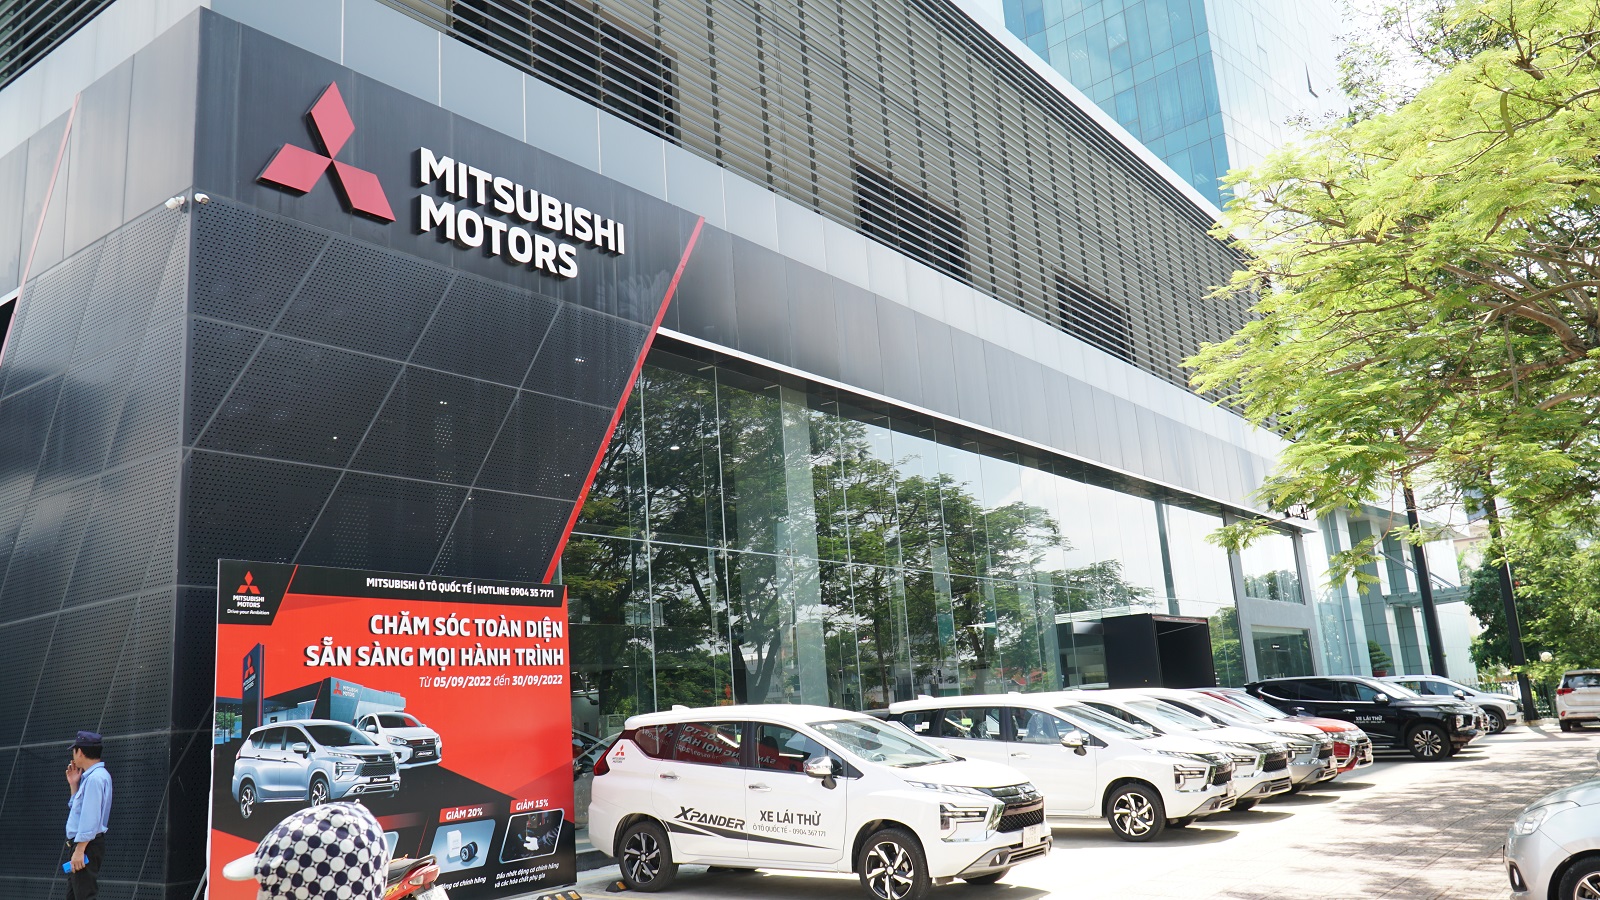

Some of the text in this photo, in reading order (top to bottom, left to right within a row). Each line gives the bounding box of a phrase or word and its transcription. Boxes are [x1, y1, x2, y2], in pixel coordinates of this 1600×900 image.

[419, 146, 625, 255] MITSUBISHI
[419, 194, 578, 279] MOTORS
[366, 577, 418, 591] MITSUBISHI
[419, 579, 426, 591] Ô
[426, 580, 438, 592] TÔ
[438, 580, 461, 594] QUỐC
[462, 582, 473, 594] TẾ
[477, 585, 510, 596] HOTLINE
[510, 587, 529, 597] 0904
[530, 588, 539, 598] 35
[539, 589, 555, 598] 7171
[369, 611, 563, 643] CHĂM SÓC TOÀN DIỆN
[304, 636, 564, 672] SẴN SÀNG MỌI HÀNH TRÌNH
[419, 673, 563, 689] Từ 05/09/2022 đến 30/09/2022
[446, 806, 484, 820] GIẢM 20%
[515, 798, 549, 811] GIẢM 15%
[673, 805, 746, 831] XPANDER
[759, 809, 822, 827] XE LÁI THỬ
[792, 828, 807, 836] 0904
[807, 829, 818, 837] 367
